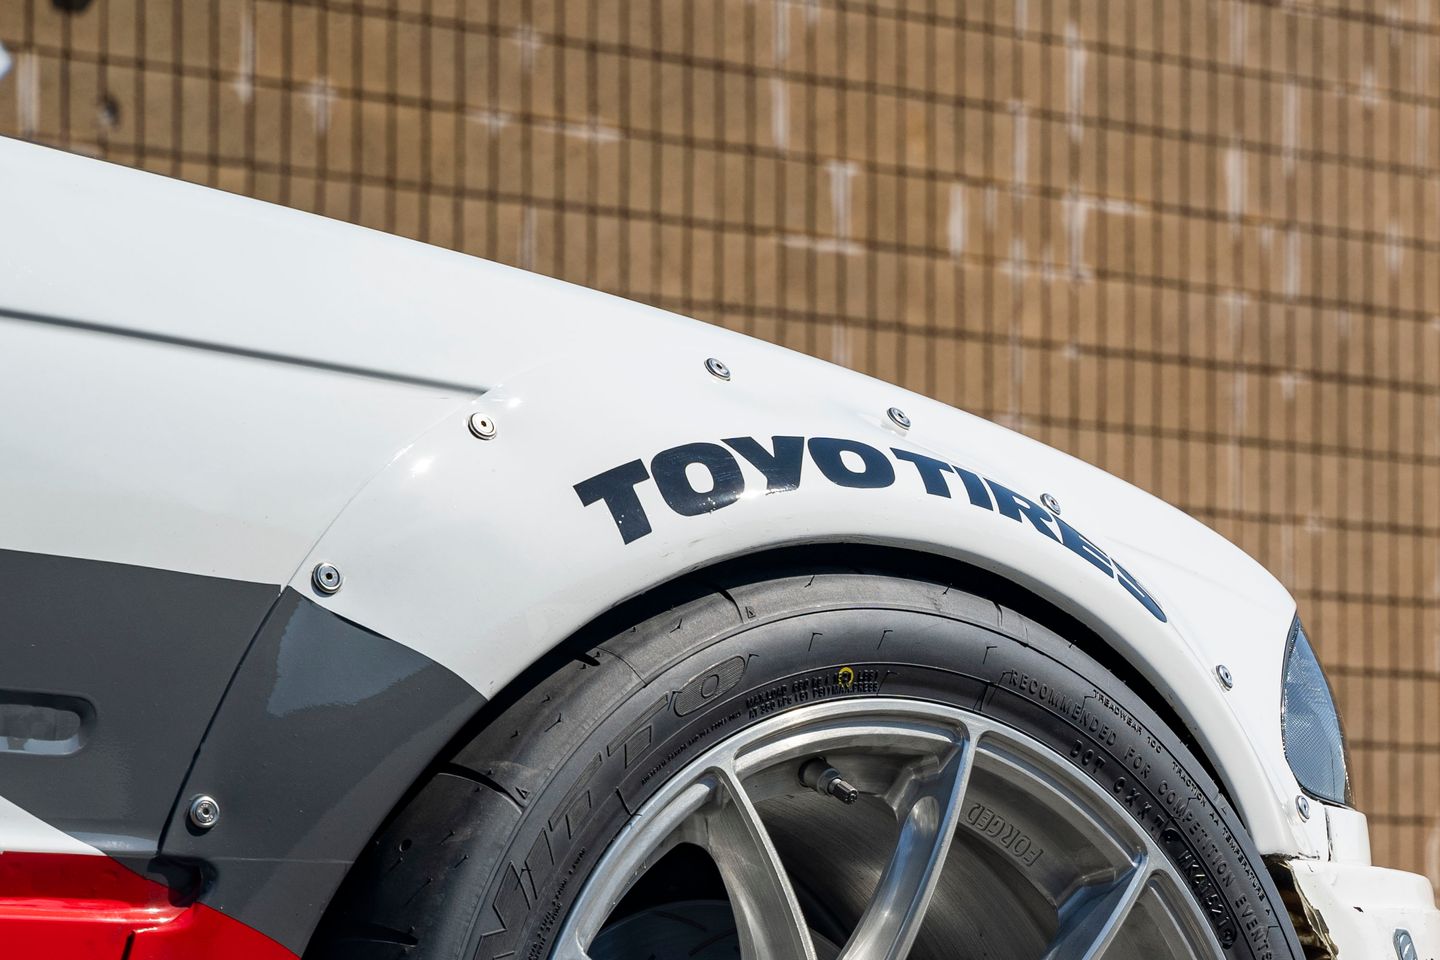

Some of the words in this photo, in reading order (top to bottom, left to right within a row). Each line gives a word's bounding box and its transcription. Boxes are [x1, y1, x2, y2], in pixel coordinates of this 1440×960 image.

[1009, 669, 1117, 746] RECOMMENDED
[1124, 747, 1151, 778] FOR
[1156, 780, 1234, 886] COMPETITION
[1070, 739, 1105, 775] DOT
[1092, 690, 1143, 735] TREADWEAR
[1171, 762, 1206, 806] TRACTION
[1209, 810, 1220, 826] AA
[1220, 827, 1265, 901] TEMPERATURE
[966, 803, 1044, 867] FORGED
